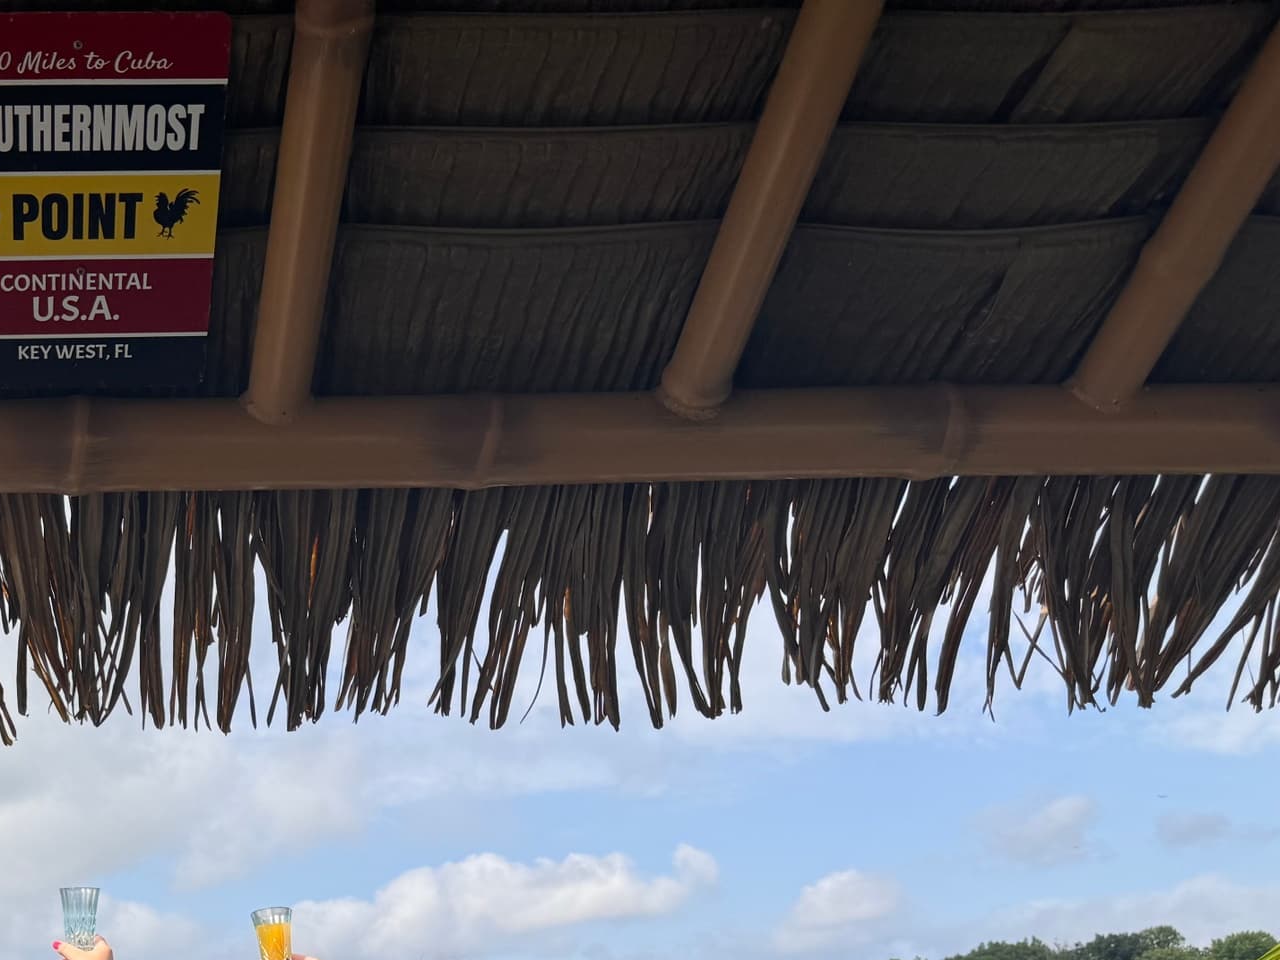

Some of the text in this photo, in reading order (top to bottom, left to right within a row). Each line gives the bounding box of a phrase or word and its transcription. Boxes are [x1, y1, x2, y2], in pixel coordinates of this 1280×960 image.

[17, 50, 77, 74] Miles
[84, 51, 110, 70] to
[113, 50, 174, 74] Cuba
[12, 193, 144, 241] POINT
[0, 272, 152, 292] CONTINENTAL
[32, 295, 120, 322] U.S.A.
[18, 344, 133, 361] KEY WEST, FL
